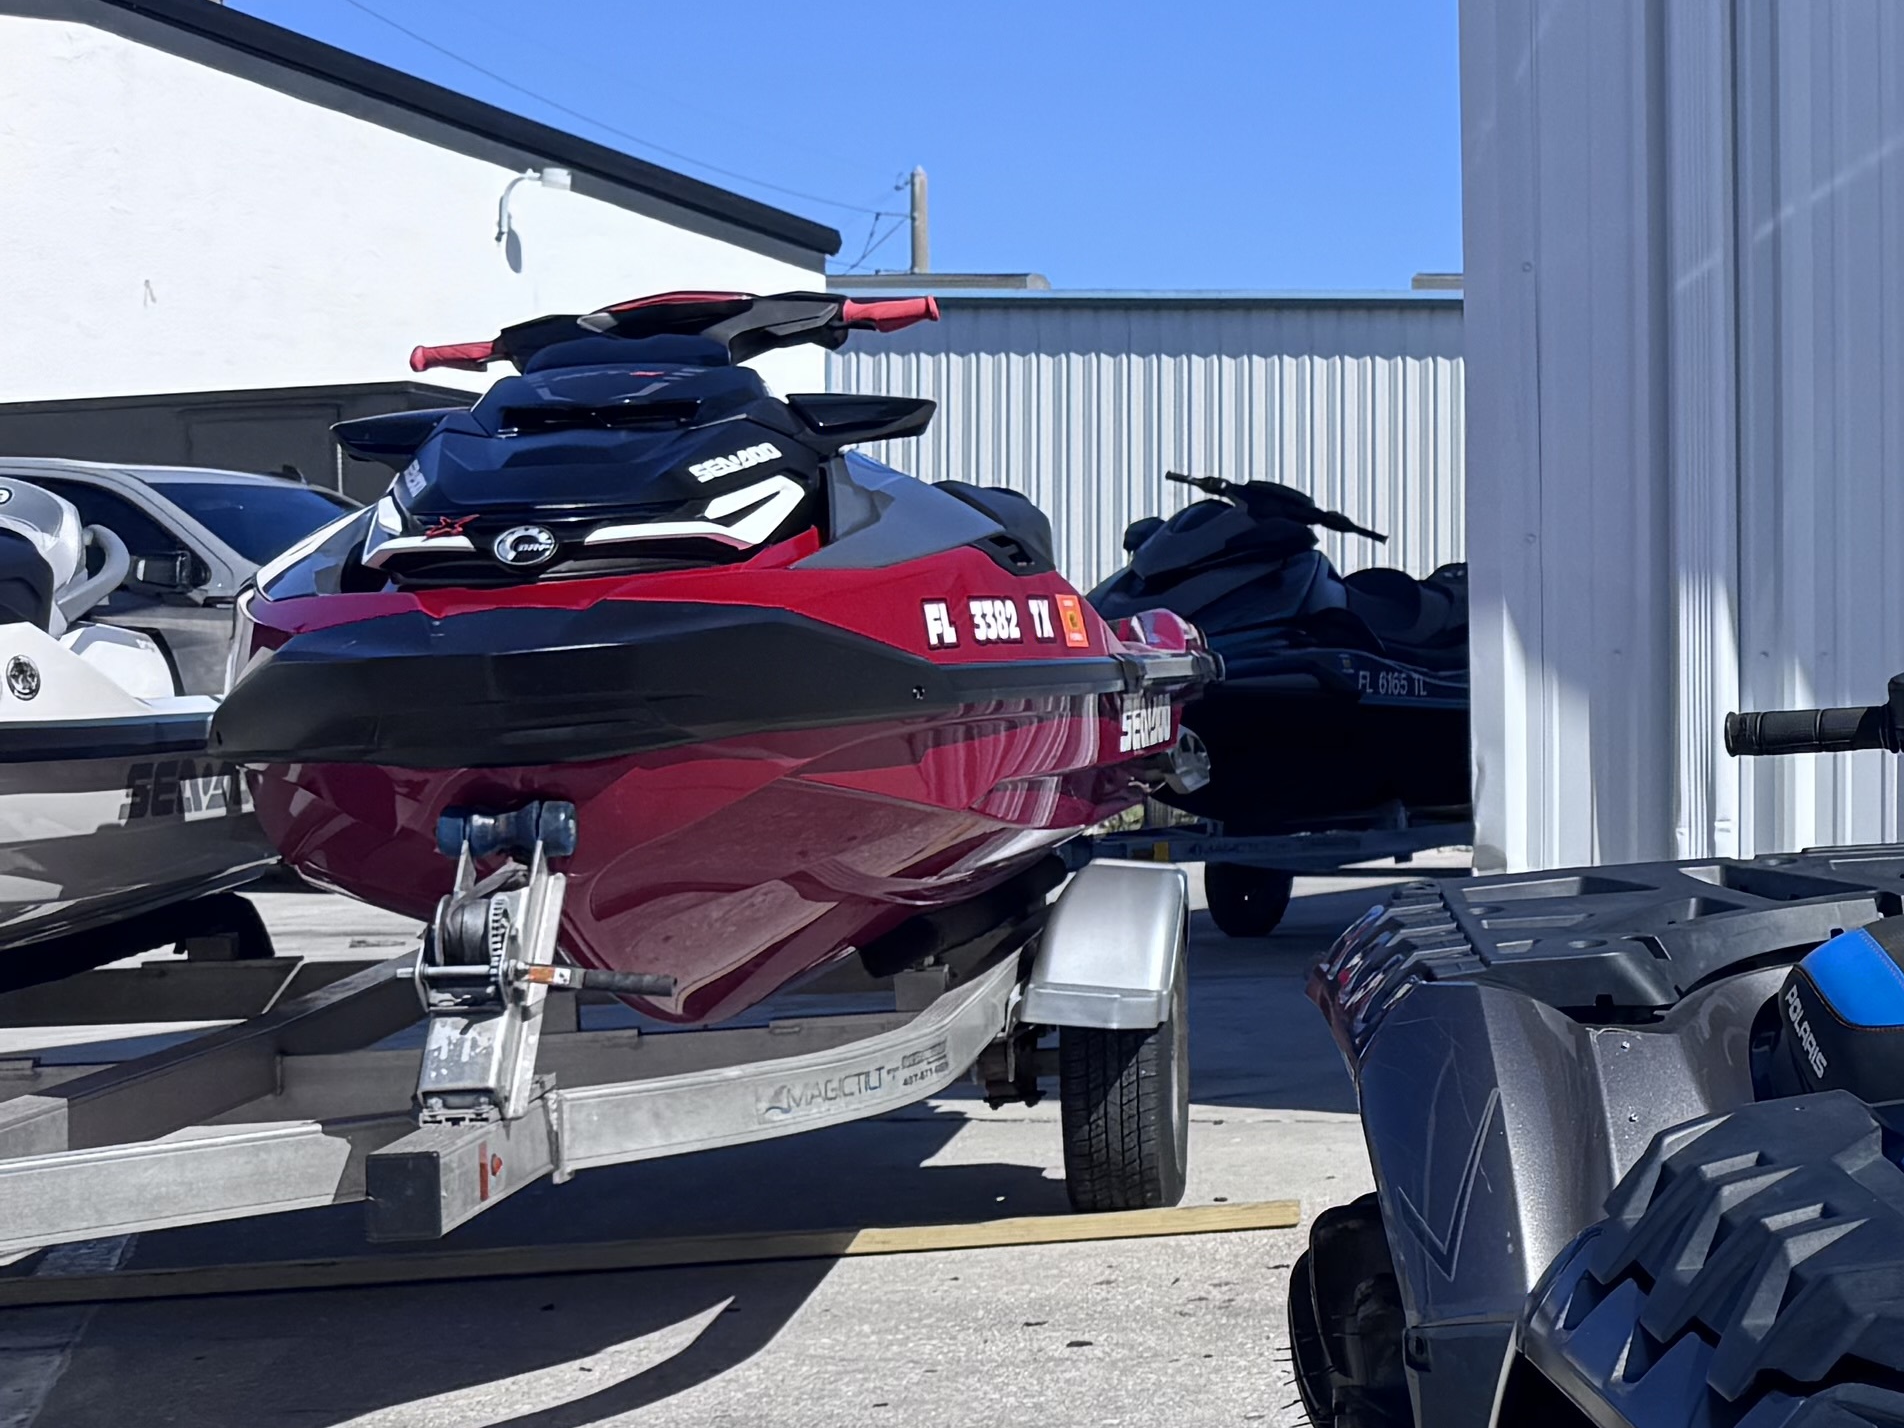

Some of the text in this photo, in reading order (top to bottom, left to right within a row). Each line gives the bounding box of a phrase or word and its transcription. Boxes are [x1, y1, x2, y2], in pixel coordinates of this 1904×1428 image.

[923, 598, 1055, 645] FL 3382 TX
[1358, 670, 1374, 694] FL
[1784, 983, 1827, 1081] POLARIS
